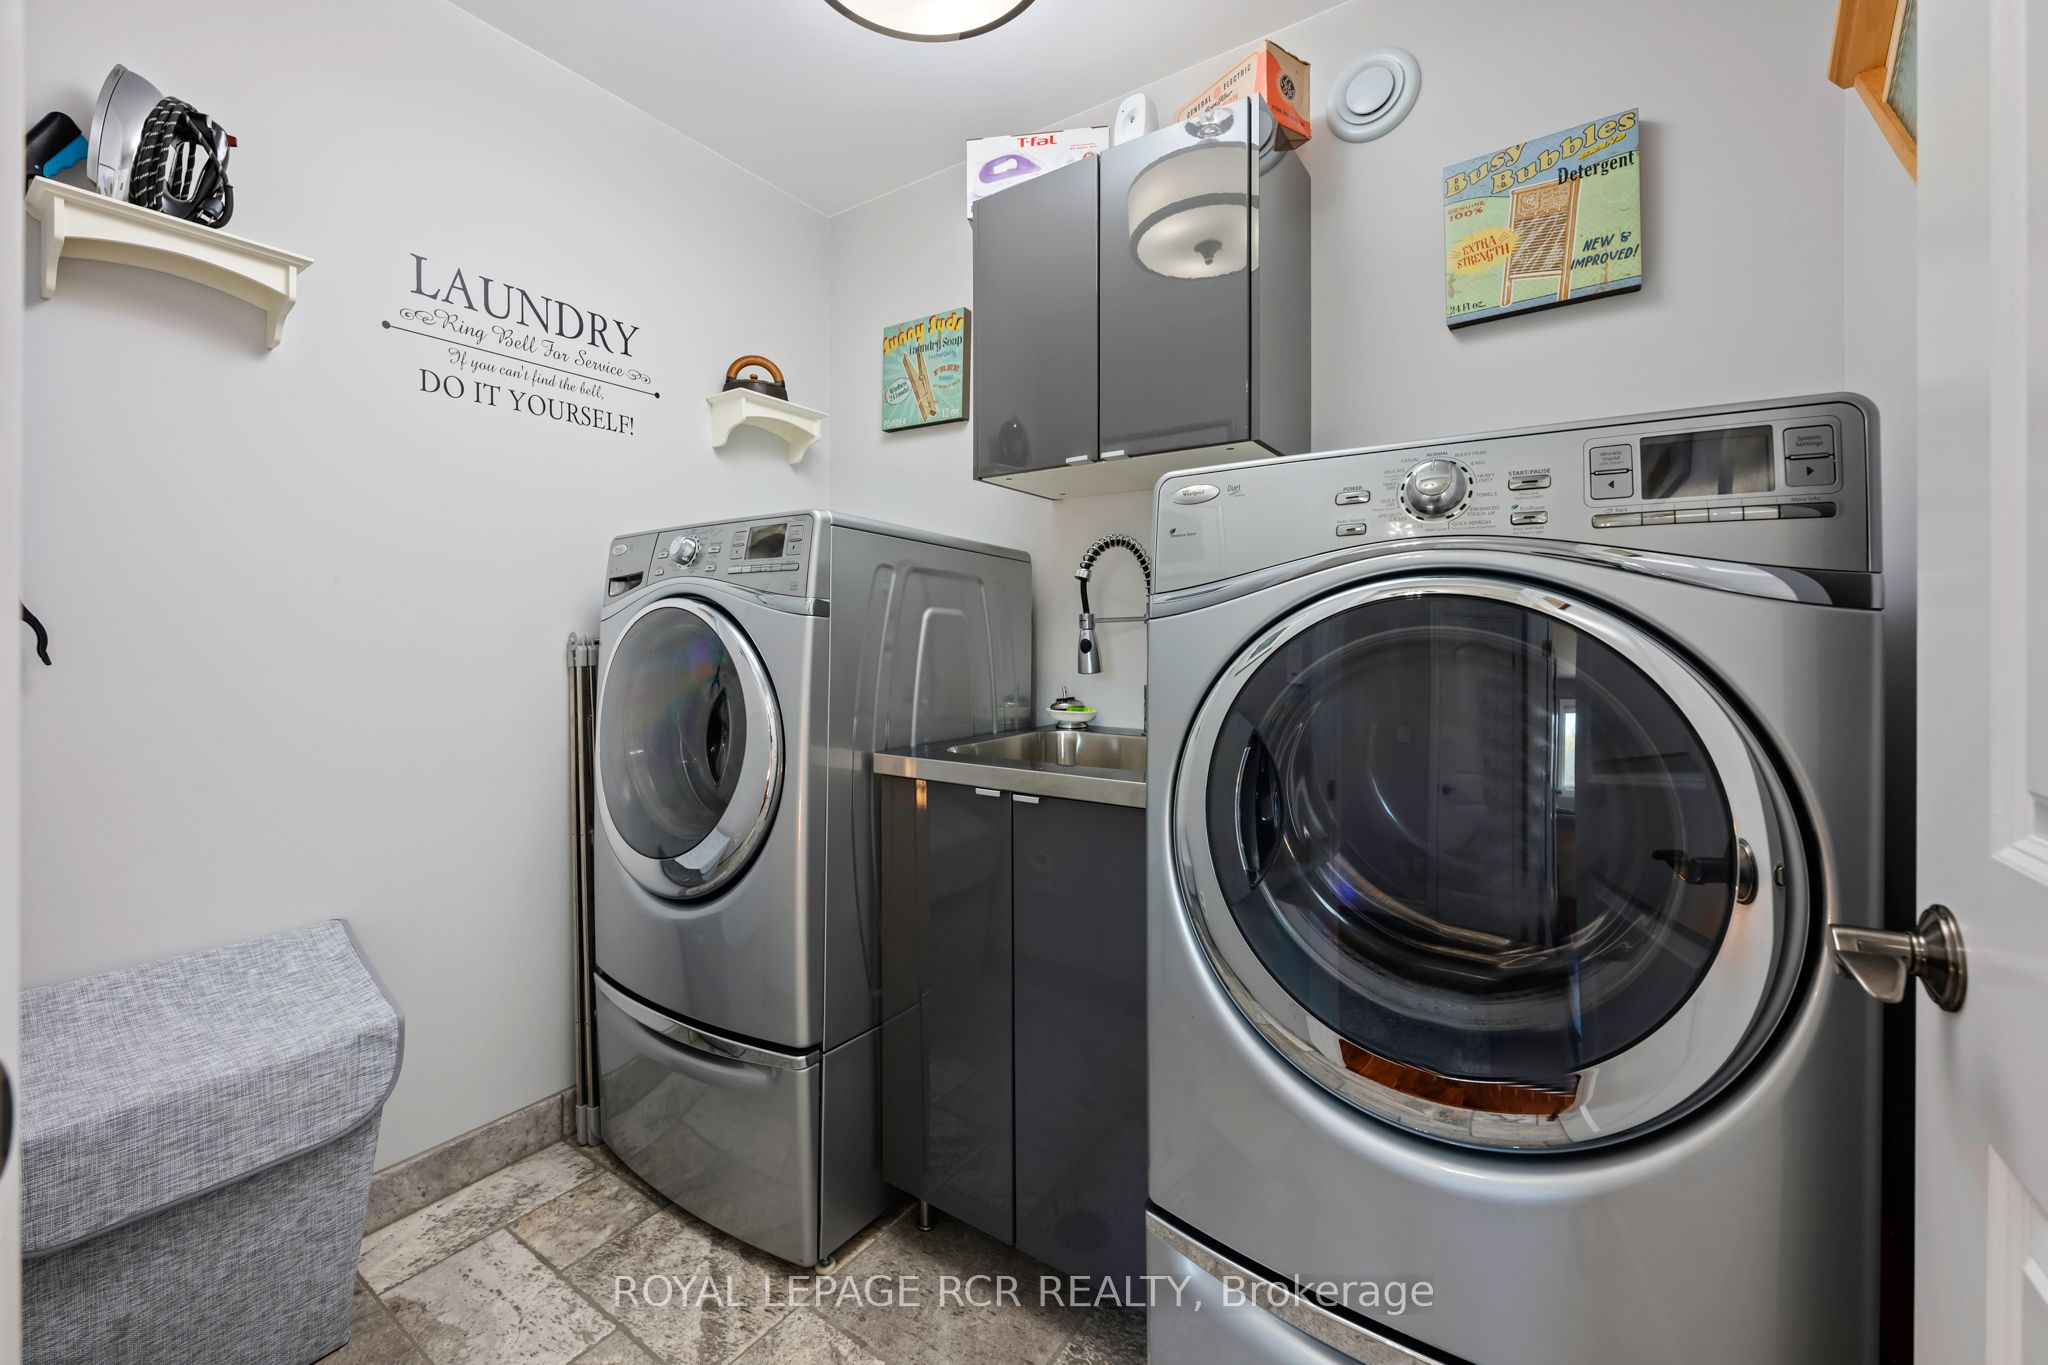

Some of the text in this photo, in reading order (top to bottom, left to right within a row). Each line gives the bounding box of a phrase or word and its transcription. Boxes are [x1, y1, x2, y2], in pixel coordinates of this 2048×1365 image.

[1186, 95, 1212, 118] GENERAL
[1223, 64, 1252, 90] ELECTRIC
[1017, 135, 1056, 148] T-fal
[1491, 111, 1636, 194] Bubbles
[1446, 142, 1527, 198] Busy
[1558, 150, 1634, 185] Detergent
[1447, 200, 1486, 216] GENUINE
[1449, 206, 1484, 222] 100%
[1456, 242, 1510, 270] STRENGTH
[1462, 234, 1497, 255] EXTRA
[1583, 232, 1632, 252] NEW &
[1571, 244, 1640, 270] IMPROVED!
[410, 252, 640, 358] LAUNDRY
[434, 308, 625, 378] Ring Bell For Service
[883, 312, 964, 356] Sunny Suds
[909, 339, 942, 356] Laundry
[448, 347, 468, 370] If
[470, 357, 497, 374] you
[500, 365, 530, 382] can't
[531, 369, 558, 389] find
[558, 375, 577, 392] the
[418, 368, 635, 436] DO IT YOURSELF!
[1508, 468, 1551, 476] START/PAUSE
[1228, 484, 1240, 492] Duet
